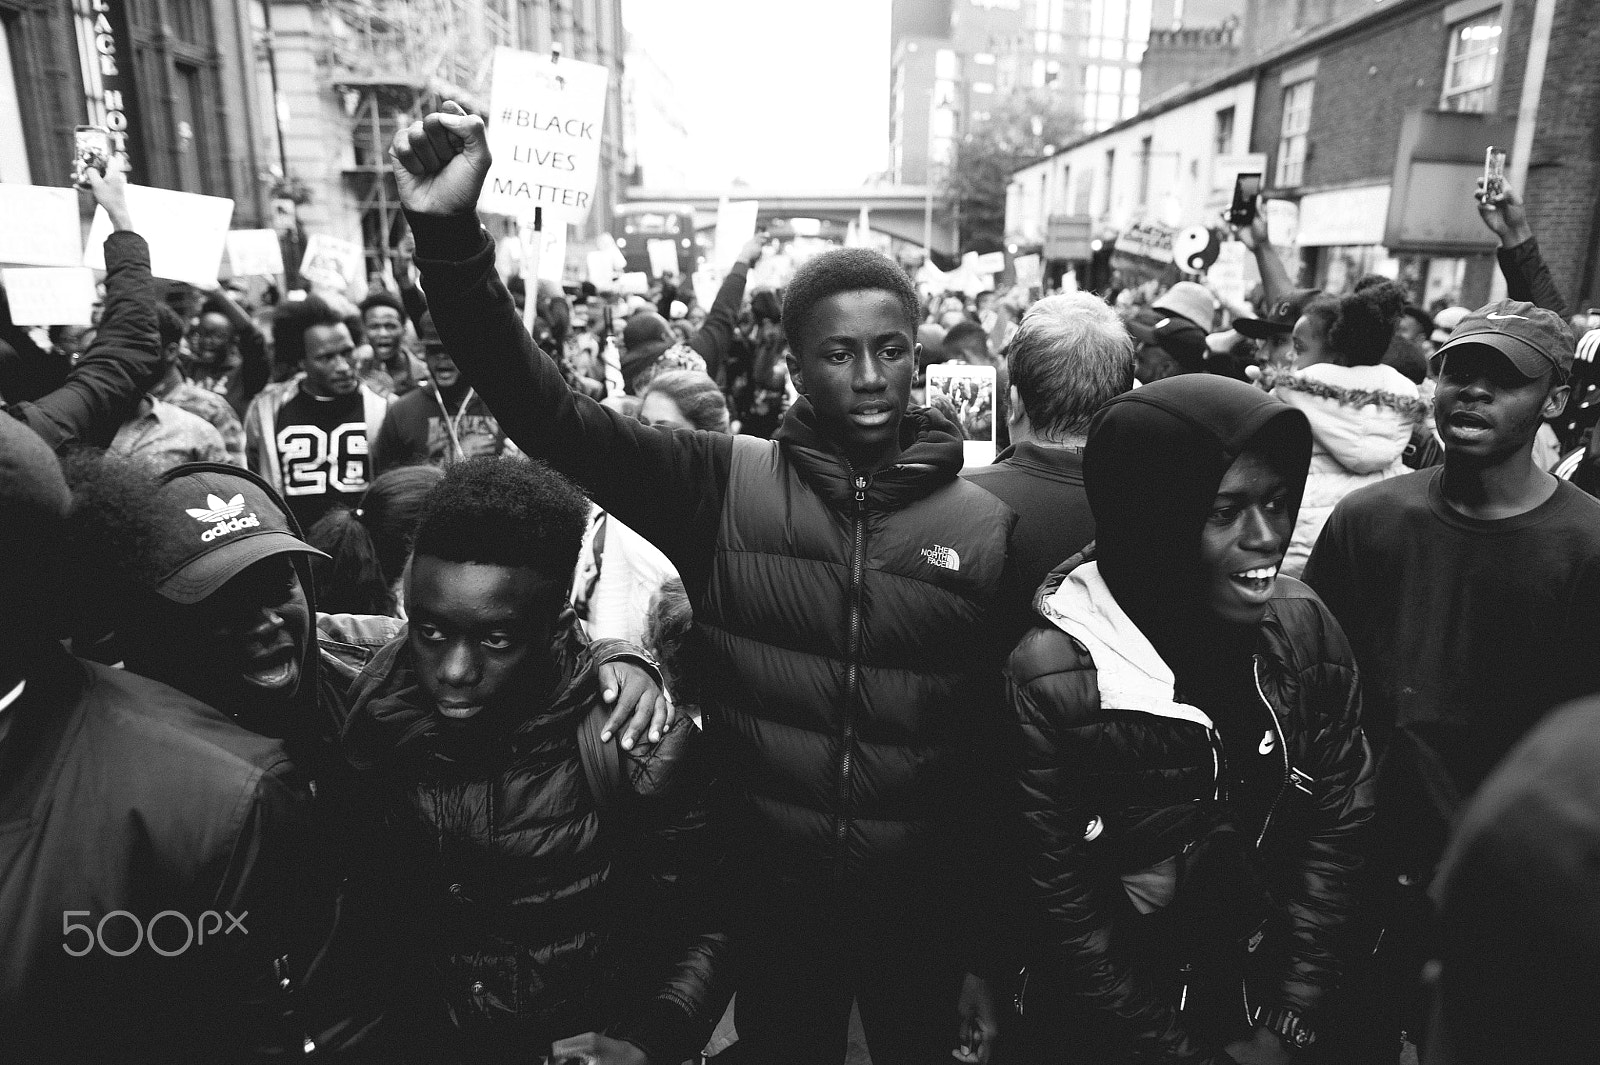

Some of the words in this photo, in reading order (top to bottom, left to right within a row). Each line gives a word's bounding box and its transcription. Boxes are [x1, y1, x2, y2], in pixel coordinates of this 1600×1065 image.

[103, 89, 133, 172] HOTE
[501, 108, 593, 140] #BLACK
[513, 145, 576, 172] LIVES
[492, 178, 589, 208] MATTER
[276, 422, 369, 496] 26
[200, 515, 260, 542] adidas
[921, 548, 948, 560] NORTH
[927, 556, 947, 568] FACE
[934, 544, 949, 554] THE
